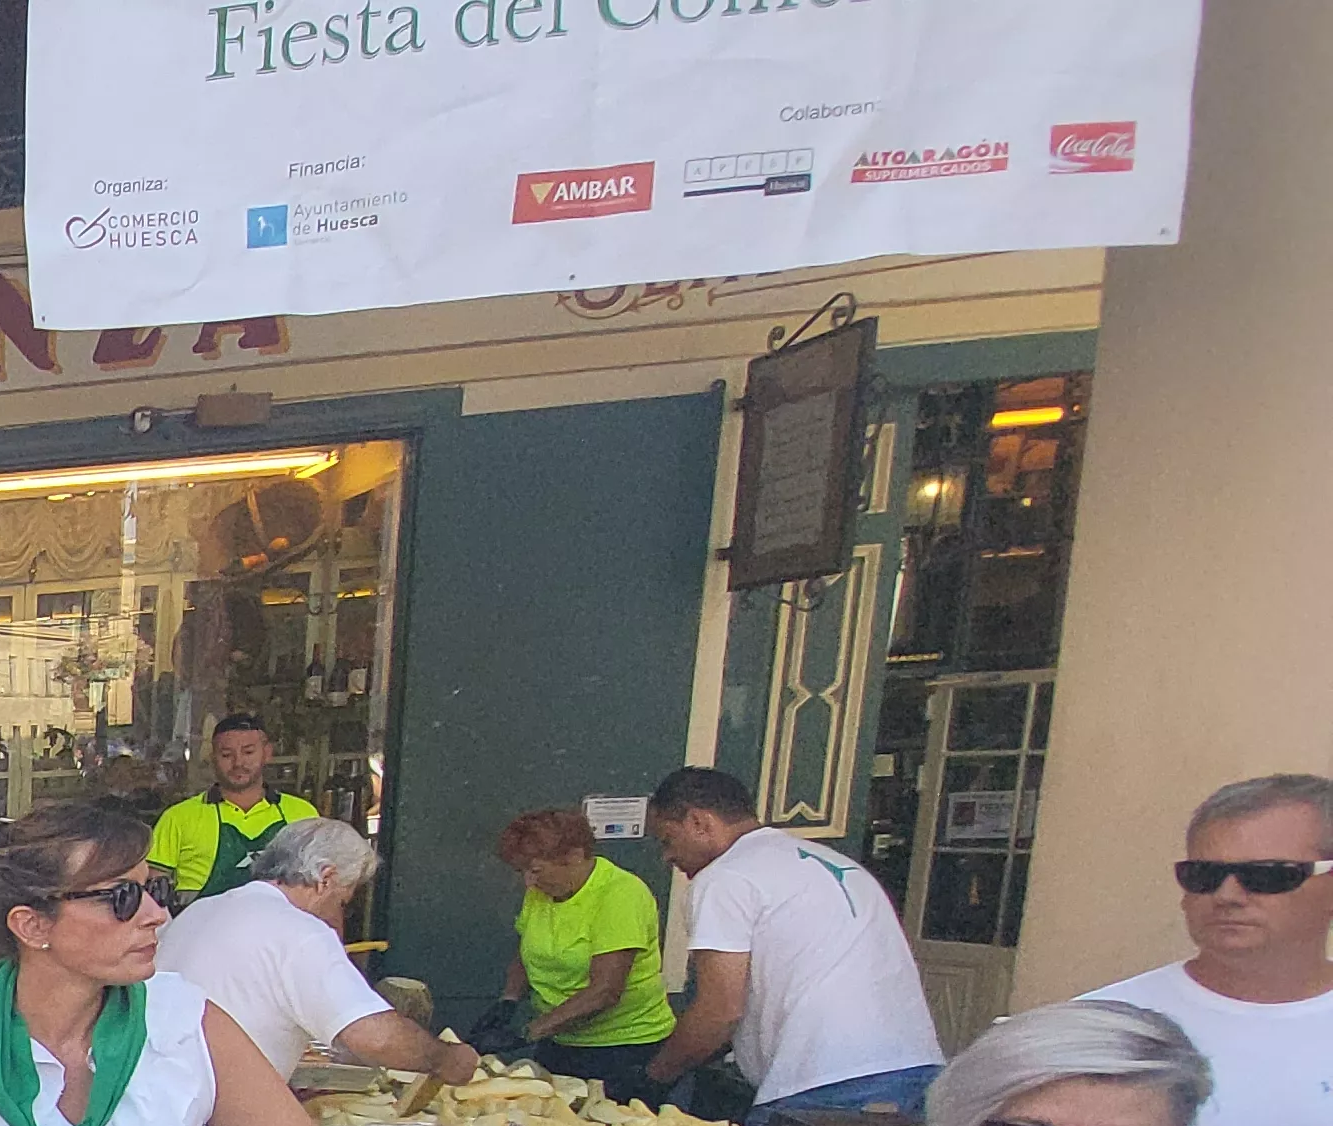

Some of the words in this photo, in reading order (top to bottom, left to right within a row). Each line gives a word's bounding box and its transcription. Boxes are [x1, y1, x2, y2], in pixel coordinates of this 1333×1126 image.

[205, 1, 426, 82] Fiesta
[288, 155, 366, 180] Financia:
[864, 160, 992, 182] SUPERMERCADOS
[94, 178, 168, 199] Organiza:
[552, 176, 637, 202] AMBAR
[293, 190, 408, 220] Ayuntamiento
[108, 209, 199, 229] COMERCIO
[293, 221, 311, 236] de
[316, 212, 379, 235] Huesca
[109, 229, 199, 250] HUESCA
